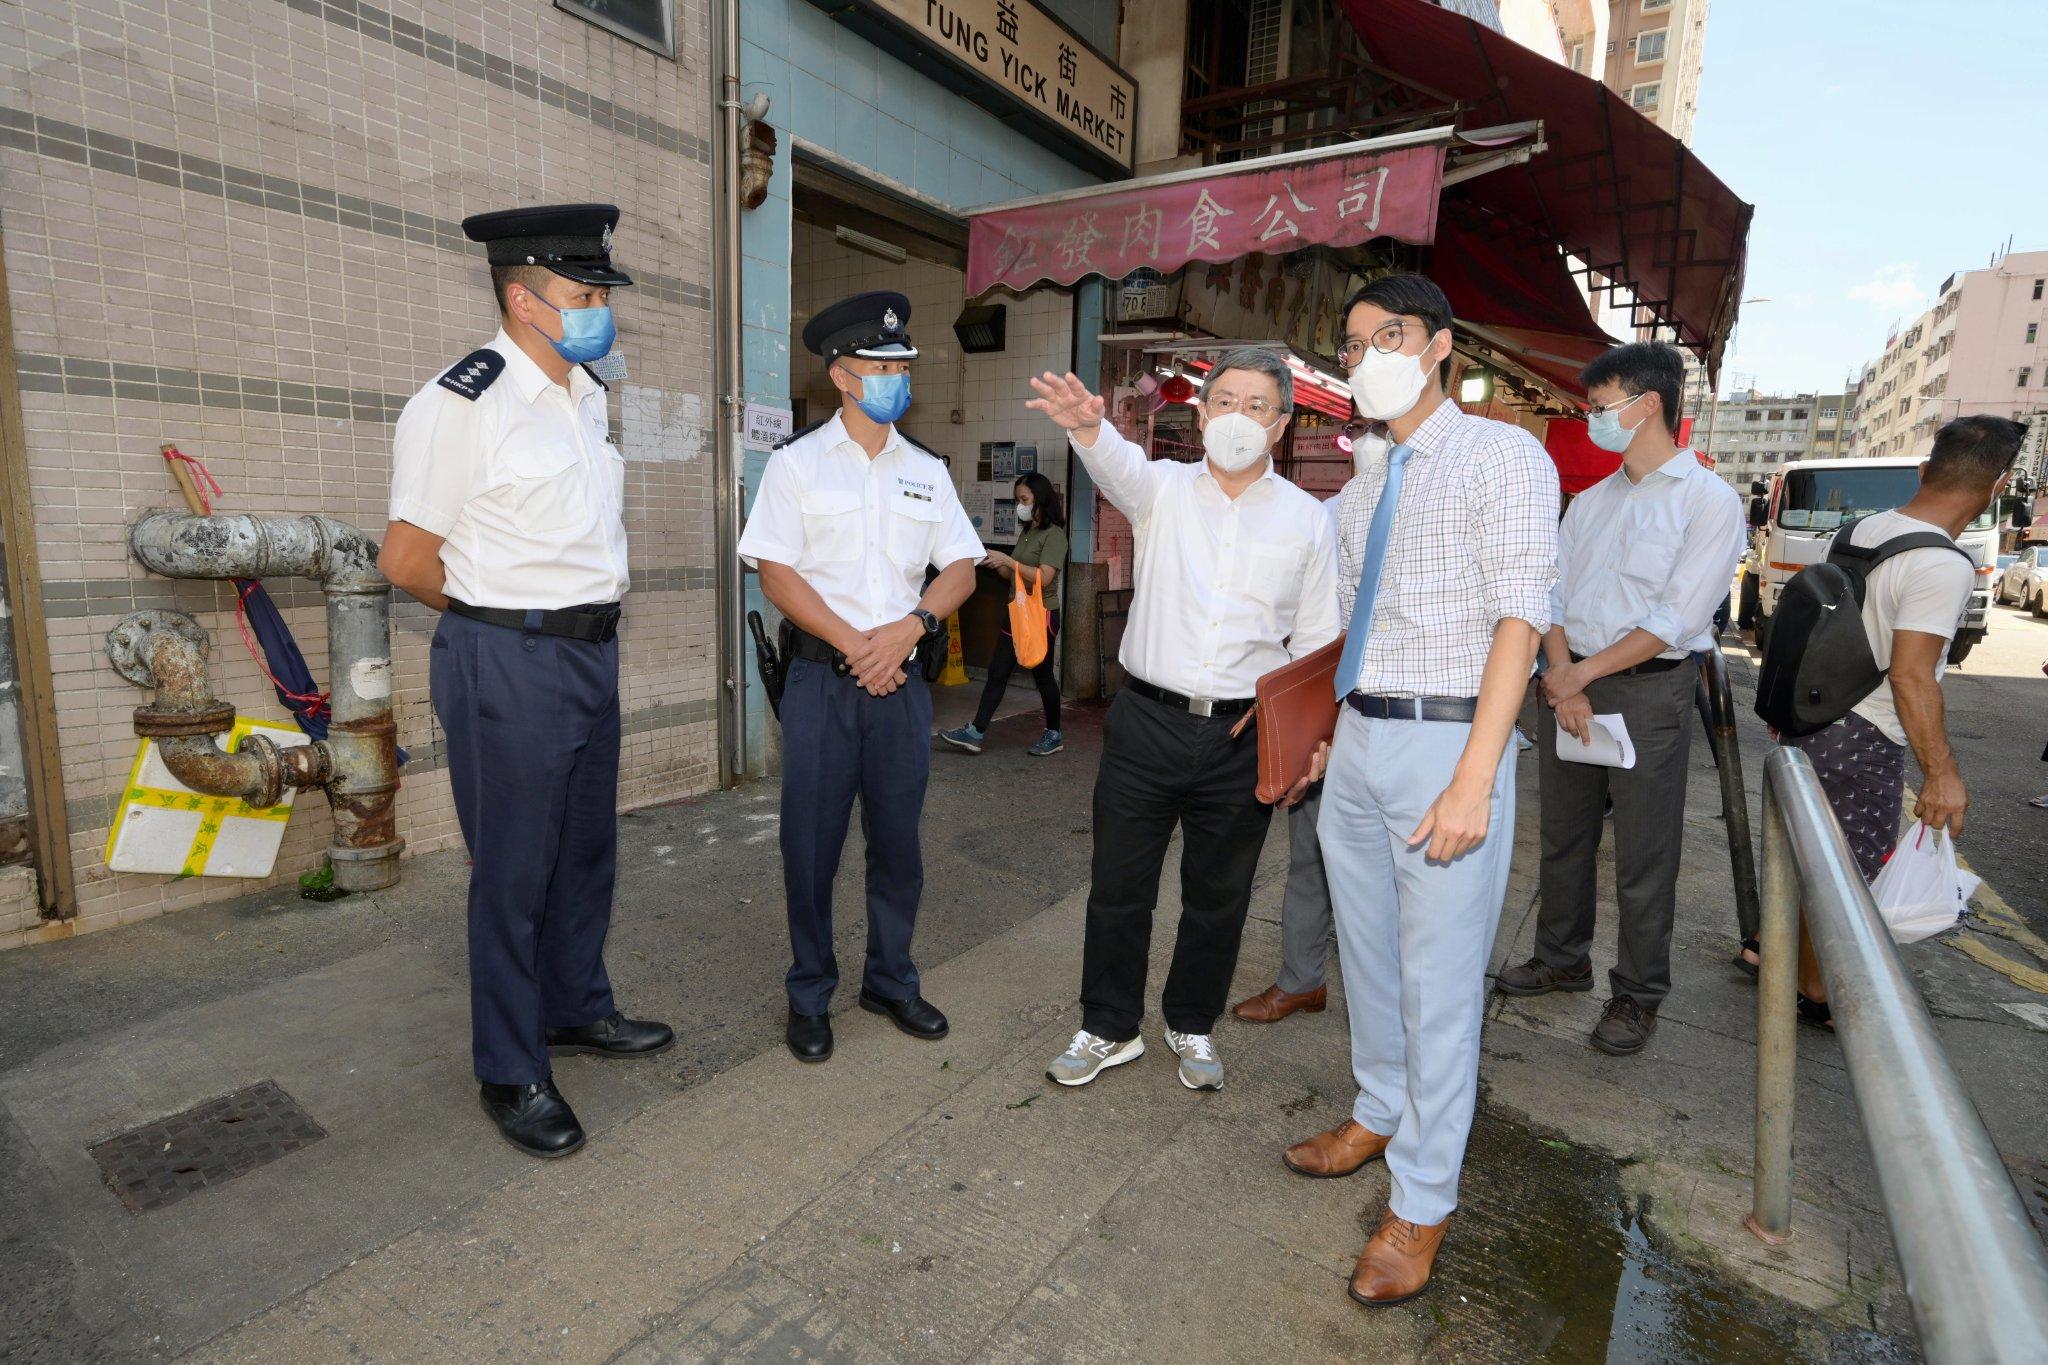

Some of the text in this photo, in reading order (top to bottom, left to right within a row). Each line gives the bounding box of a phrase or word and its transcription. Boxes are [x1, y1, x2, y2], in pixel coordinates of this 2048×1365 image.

[925, 0, 1126, 155] TUNG YICK MARKET
[755, 413, 782, 429] 紅外線
